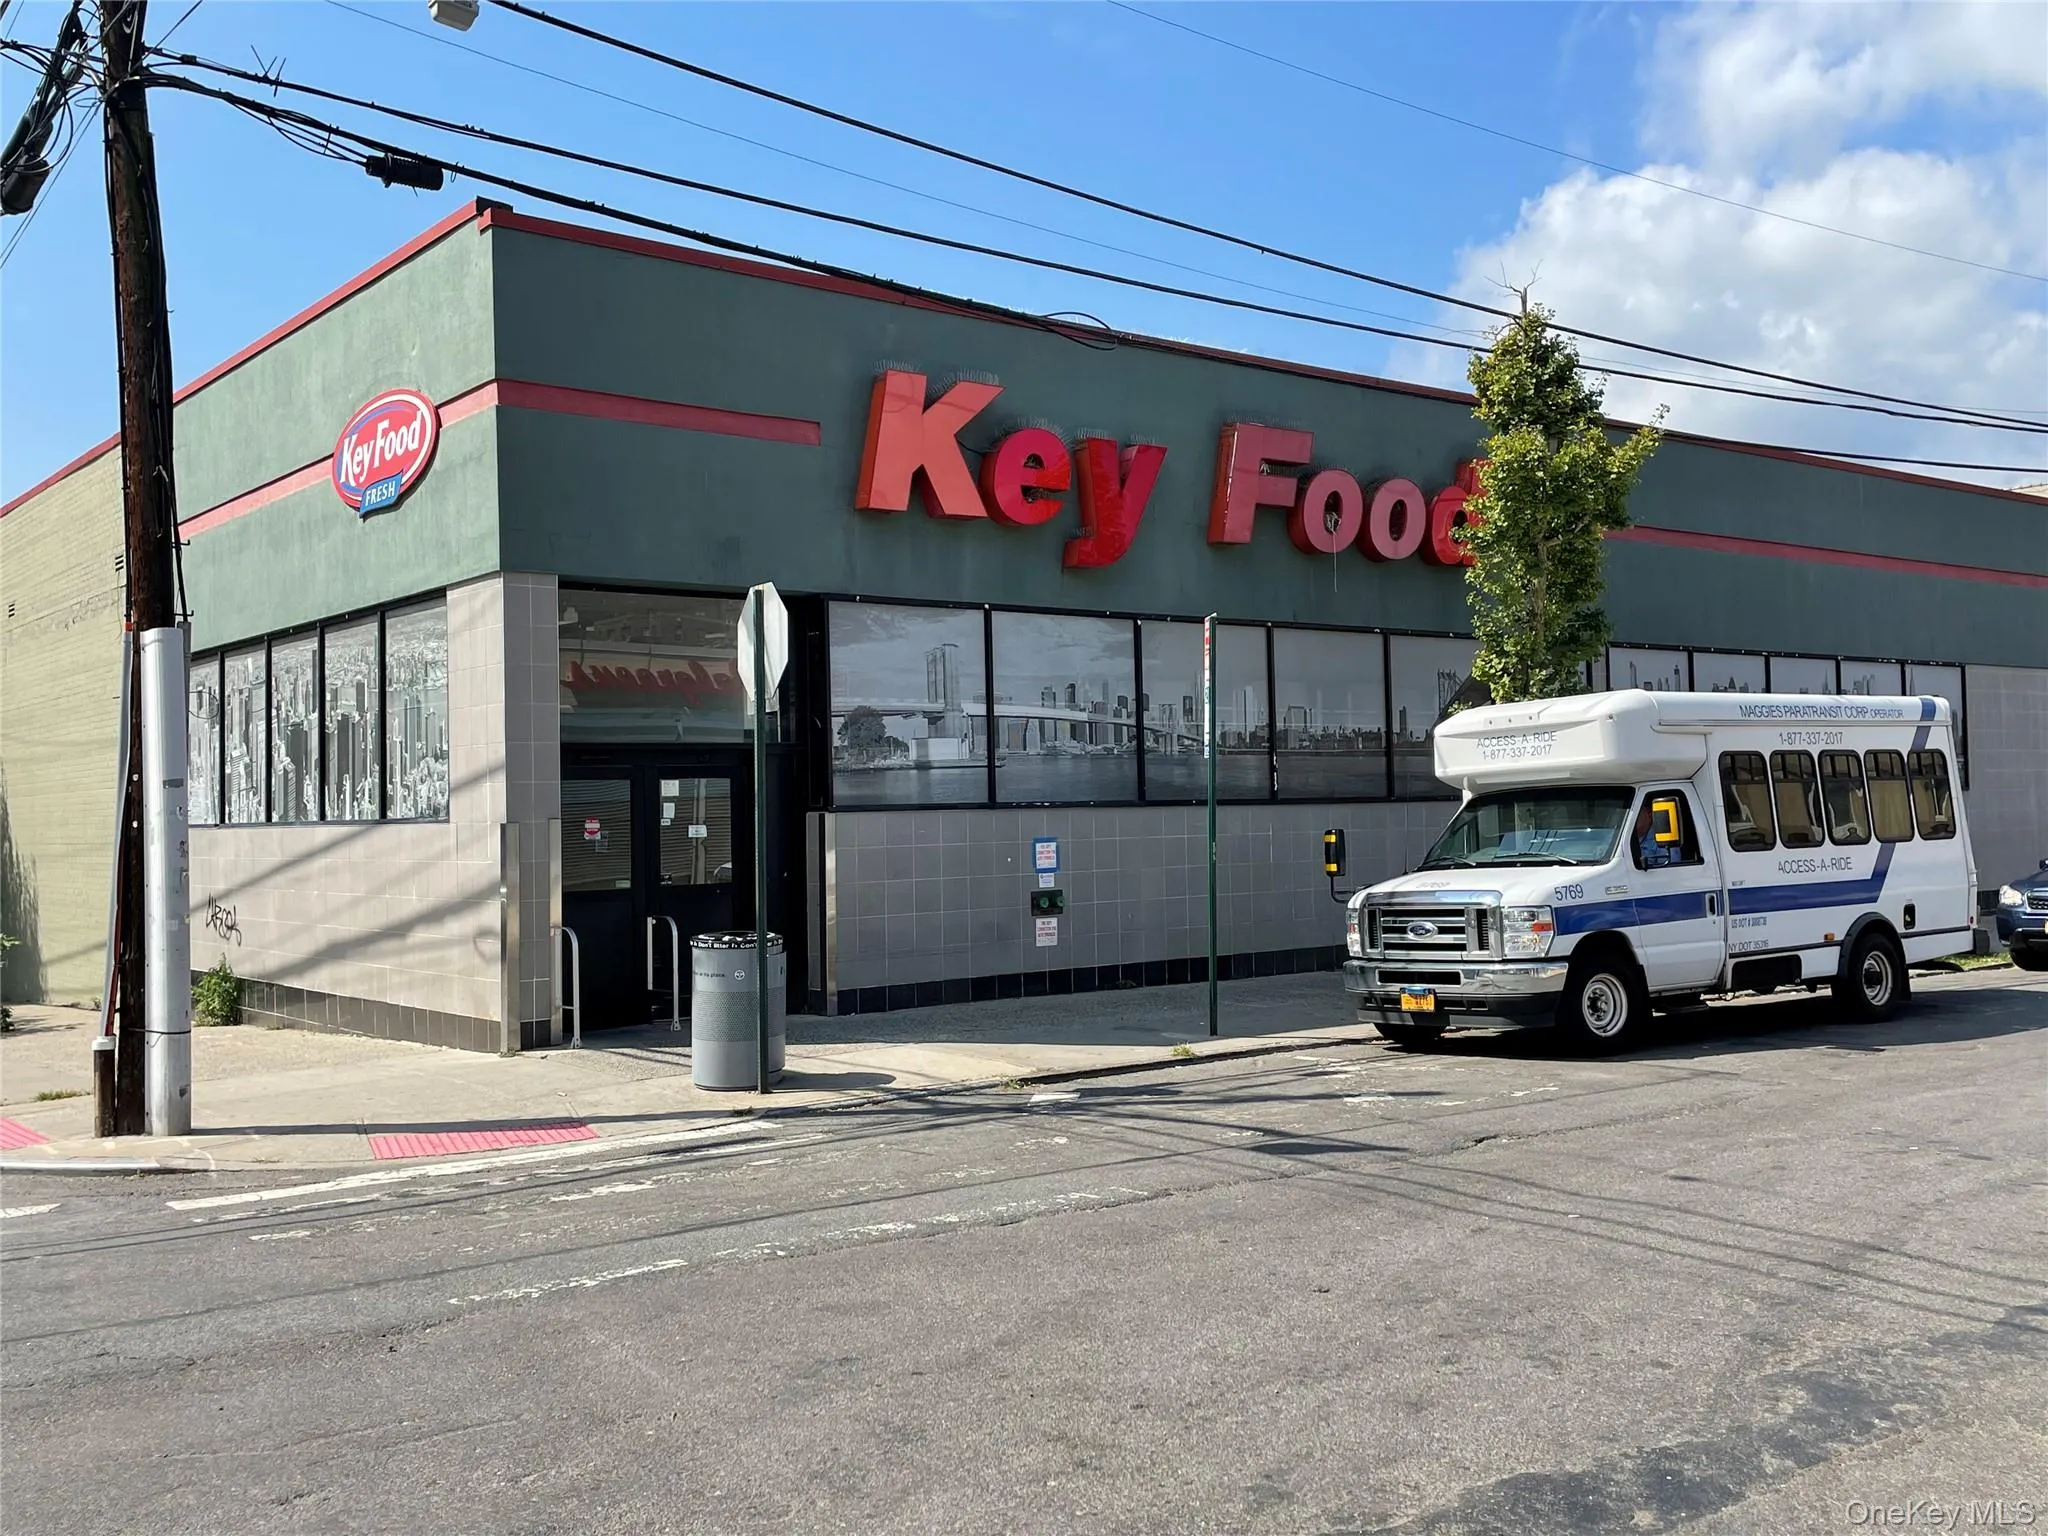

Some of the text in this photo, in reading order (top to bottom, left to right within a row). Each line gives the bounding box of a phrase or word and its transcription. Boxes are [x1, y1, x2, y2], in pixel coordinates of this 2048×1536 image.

[340, 409, 422, 487] Key Food
[856, 366, 1168, 570] Key
[365, 481, 396, 506] FRESH
[1739, 704, 1783, 719] MAGGIES
[1784, 705, 1844, 719] PARATRANSIT
[1870, 708, 1904, 719] OPERATOR
[1779, 731, 1843, 745] 1-877-337-2017
[1483, 744, 1552, 760] 1-877-337-2017
[1778, 857, 1853, 874] ACCESS-A-RIDE
[1554, 883, 1584, 901] 5769
[1728, 942, 1738, 952] NY
[1738, 941, 1752, 951] DOT
